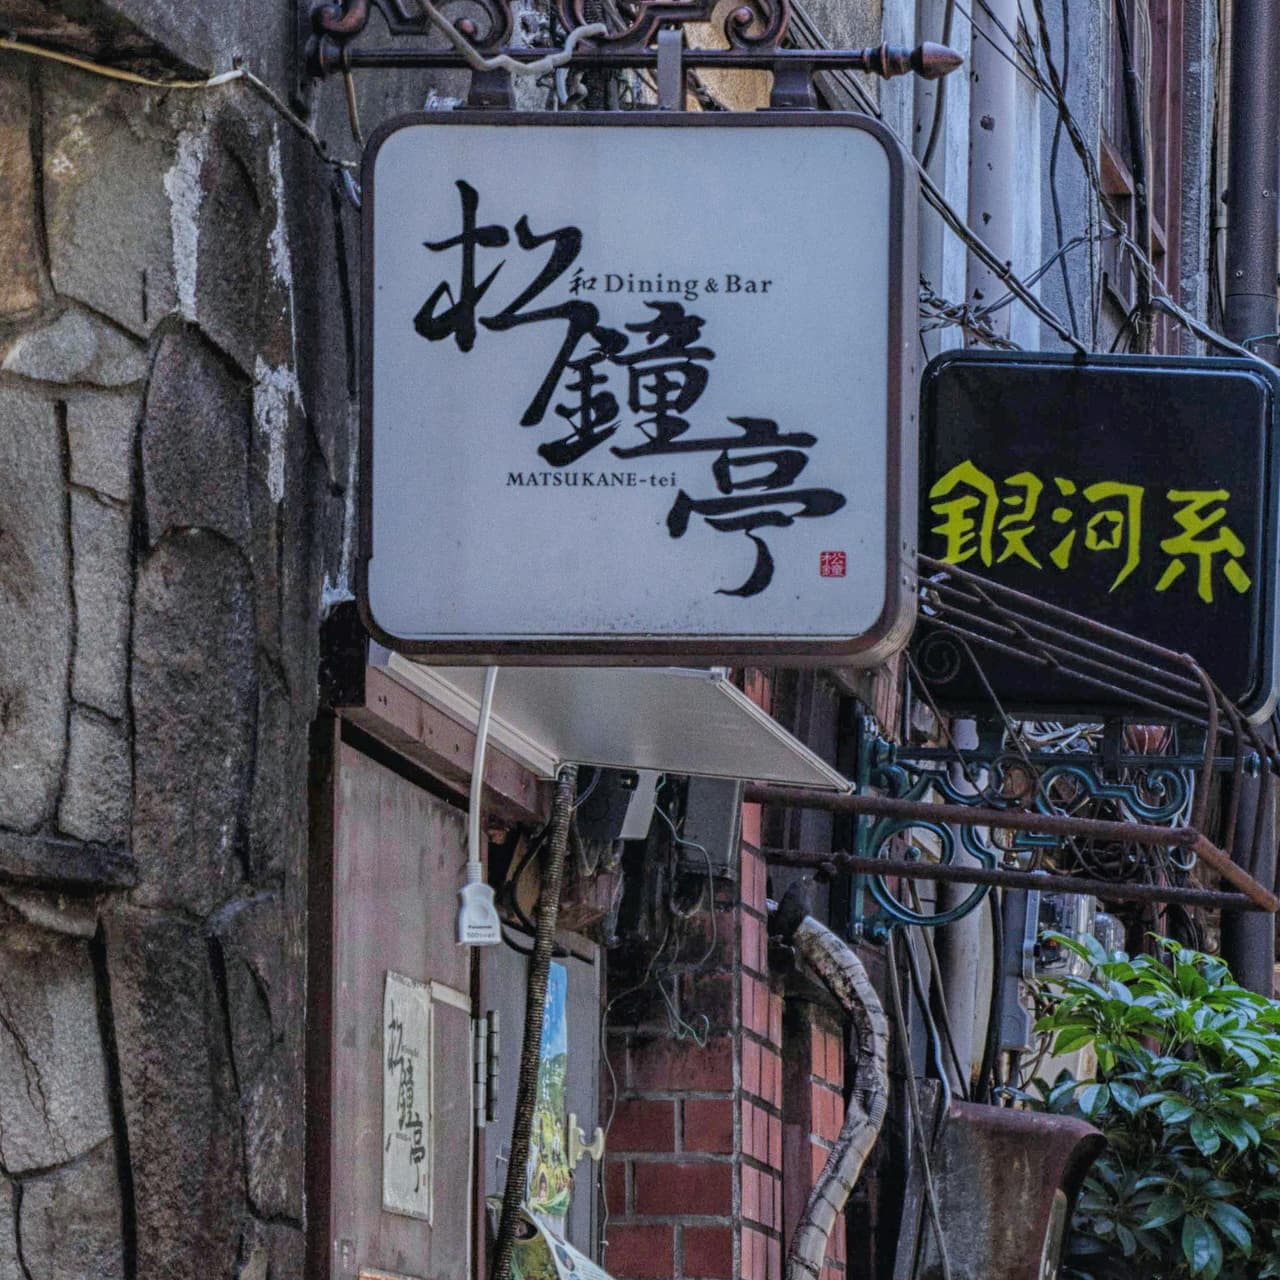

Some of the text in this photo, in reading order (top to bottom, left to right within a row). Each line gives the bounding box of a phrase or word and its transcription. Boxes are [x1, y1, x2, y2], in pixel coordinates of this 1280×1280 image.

[569, 267, 774, 301] 和 Dining & Bar
[506, 471, 678, 488] MATSUKANE-tei
[928, 458, 1253, 604] 銀河系
